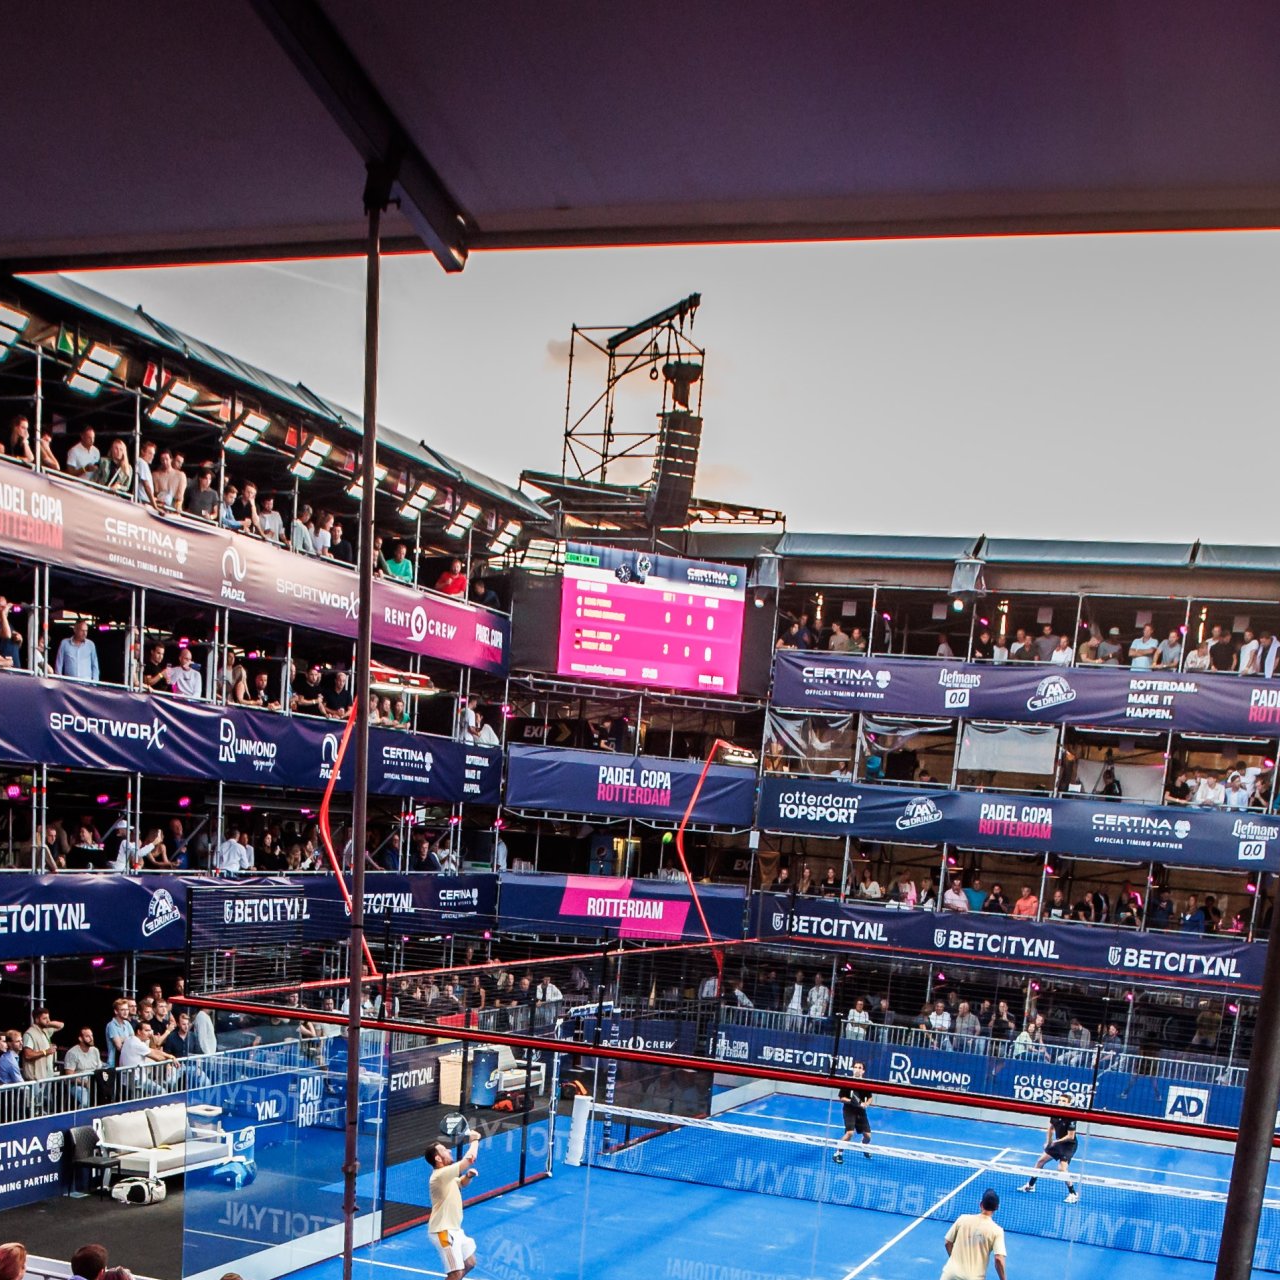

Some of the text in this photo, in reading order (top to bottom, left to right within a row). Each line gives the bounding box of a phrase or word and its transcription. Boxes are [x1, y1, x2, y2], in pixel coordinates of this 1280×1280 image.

[31, 491, 63, 524] COPA
[105, 517, 173, 548] CERTINA
[109, 554, 184, 579] OFFICIAL TIMING PARTNER
[221, 586, 245, 602] PADEL
[802, 666, 874, 680] CERTINA
[805, 689, 884, 699] OFFICIAL TIMING PARTNER
[1130, 679, 1197, 693] ROTTERDAM.
[949, 691, 966, 704] 0.0
[1042, 693, 1067, 706] DRINK
[1128, 693, 1173, 705] MAKE IT
[1126, 707, 1173, 720] HAPPEN.
[50, 712, 168, 750] SPORTWORX
[383, 746, 424, 762] CERTINA
[599, 766, 671, 789] PADEL COPA
[597, 784, 670, 807] ROTTERDAM
[779, 792, 859, 809] rotterdam
[779, 803, 858, 824] TOPSPORT
[909, 812, 934, 825] DRINK
[980, 803, 1053, 825] PADEL COPA
[1092, 814, 1171, 829] CERTINA
[978, 818, 1052, 840] ROTTERDAM
[1125, 838, 1151, 847] TIMING
[1153, 841, 1183, 849] PARTNER
[1243, 844, 1262, 857] 0.0
[587, 897, 663, 920] ROTTERDAM
[790, 915, 888, 942] BETCITY.NL
[948, 929, 1060, 960] BETCITY.NL
[1124, 948, 1241, 978] BETCITY.NL
[1168, 1094, 1204, 1117] AD
[23, 1172, 59, 1189] PARTNER
